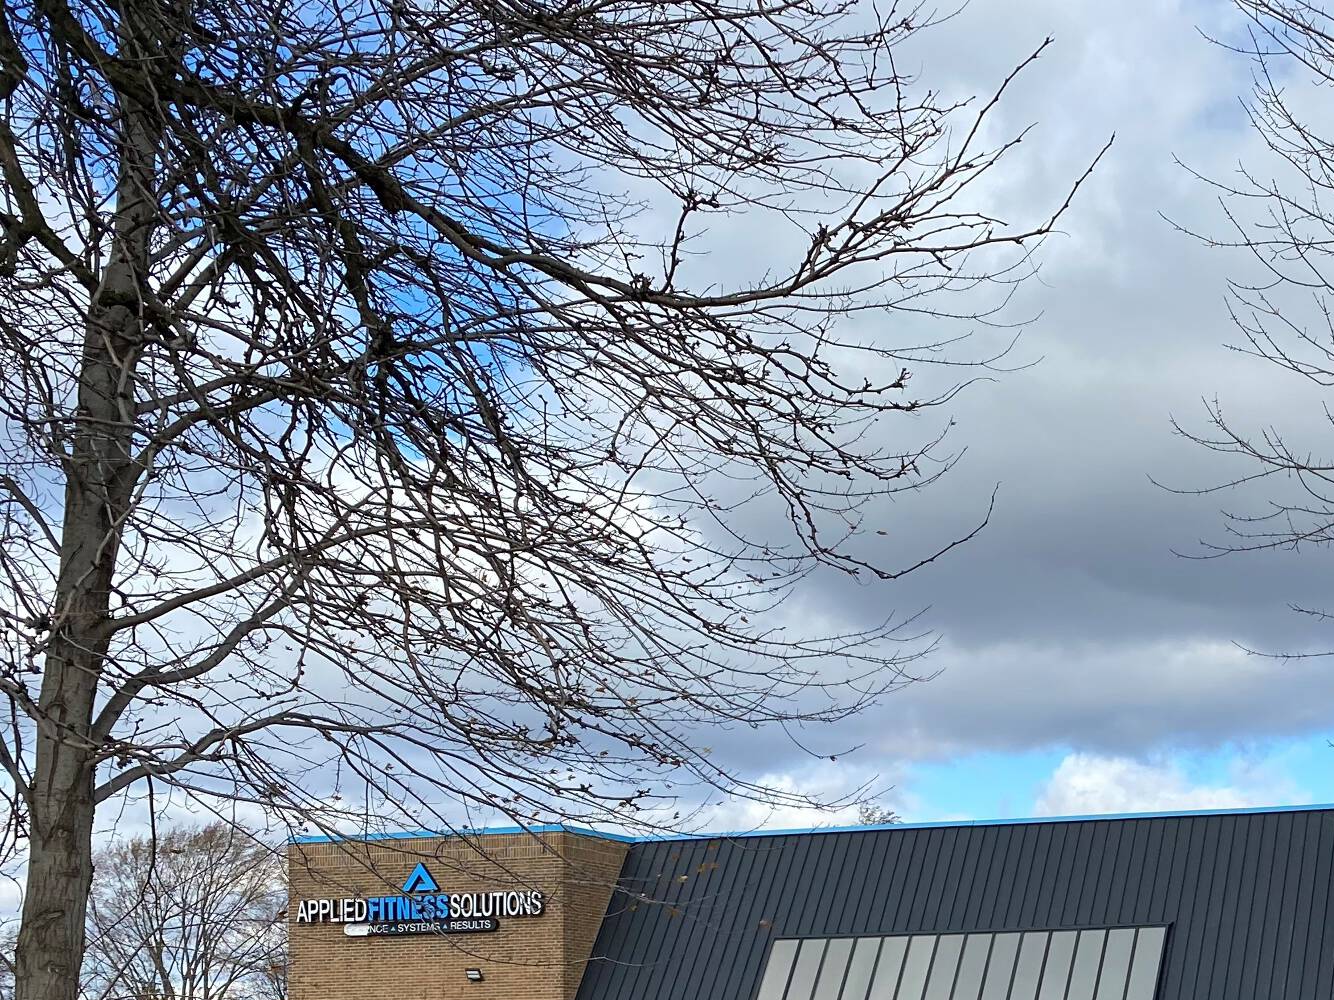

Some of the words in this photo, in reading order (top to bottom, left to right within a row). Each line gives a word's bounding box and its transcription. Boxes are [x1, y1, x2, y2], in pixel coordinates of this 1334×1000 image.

[297, 898, 367, 923] APPLIED
[368, 895, 449, 920] FITNESS
[450, 890, 542, 918] SOLUTIONS
[397, 922, 441, 933] SYSTEMS
[450, 919, 492, 931] RESULTS
